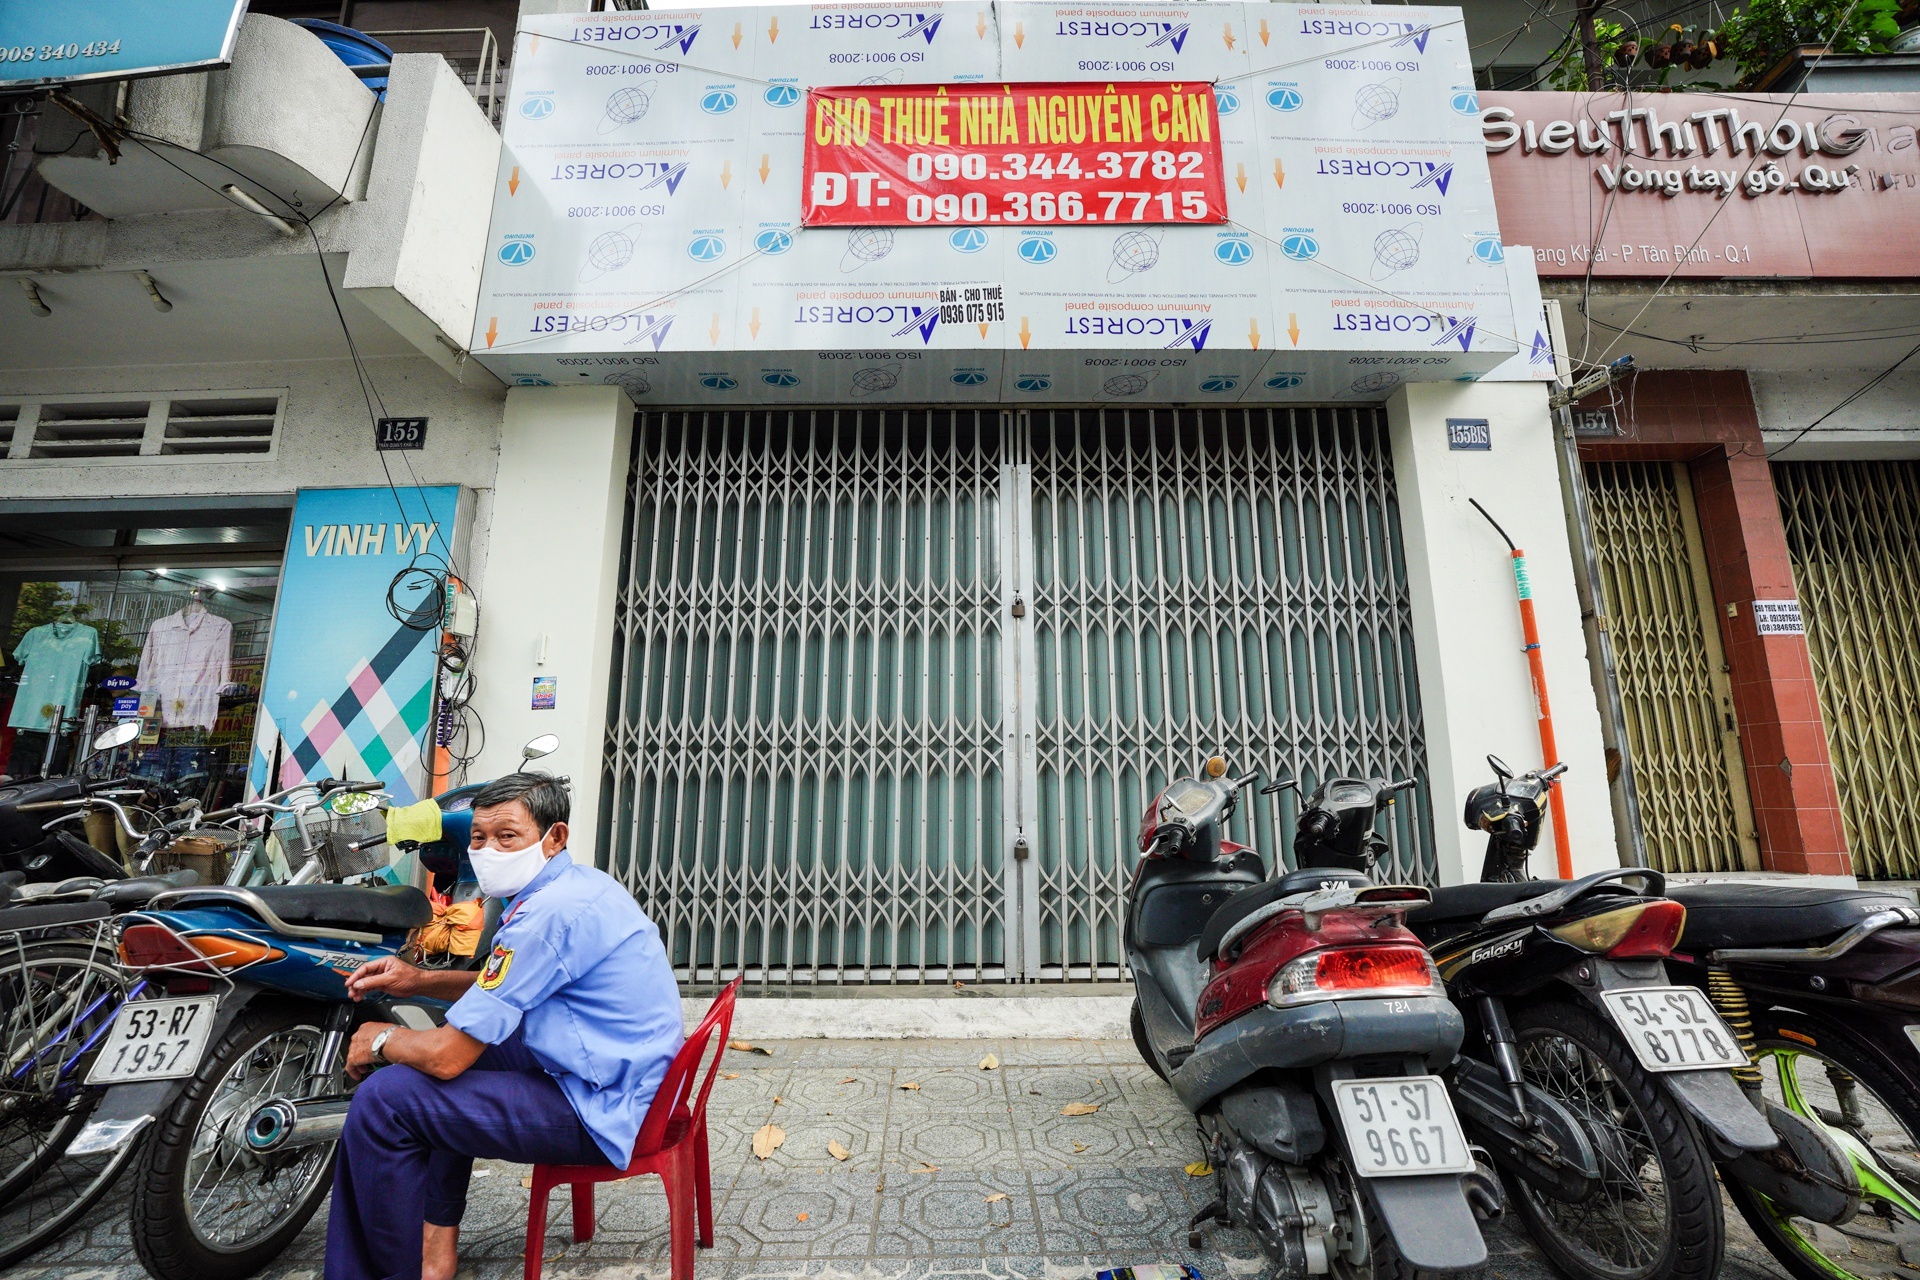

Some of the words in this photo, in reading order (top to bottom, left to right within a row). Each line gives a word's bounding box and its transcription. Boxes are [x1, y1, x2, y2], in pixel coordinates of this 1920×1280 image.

[602, 14, 651, 23] composite
[654, 12, 702, 22] Aluminum
[1056, 9, 1082, 17] panel
[1085, 9, 1136, 18] composite
[1328, 9, 1378, 18] composite
[1382, 11, 1429, 19] Aluminum
[573, 15, 599, 24] panel
[810, 13, 944, 45] ALCOREST
[570, 24, 702, 56] ALCOREST
[1056, 22, 1191, 54] ALCOREST
[1300, 20, 1431, 55] ALCOREST
[0, 47, 36, 63] 908
[38, 43, 79, 61] 340
[81, 38, 122, 57] 434
[829, 53, 895, 63] 9001:2008
[900, 52, 924, 62] ISO
[586, 64, 651, 76] 9001:2008
[655, 63, 679, 73] ISO
[1079, 60, 1145, 71] 9001:2008
[1150, 61, 1174, 71] ISO
[1325, 59, 1391, 71] 9001:2008
[1395, 61, 1420, 71] ISO
[815, 99, 871, 146] CHO
[881, 87, 950, 145] THUÊ
[960, 86, 1019, 144] NHÀ
[1030, 84, 1142, 143] NGUYÊN
[1154, 84, 1211, 143] CĂN
[555, 151, 581, 160] panel
[585, 149, 636, 159] composite
[640, 149, 690, 158] Aluminum
[1314, 146, 1342, 155] panel
[1345, 147, 1398, 156] composite
[1401, 148, 1452, 158] Aluminum
[907, 152, 1205, 181] 090.344.3782
[550, 162, 690, 197] ALCOREST
[1317, 159, 1454, 197] ALCOREST
[1601, 163, 1683, 196] Vòng
[1685, 164, 1736, 196] tay
[1743, 160, 1784, 196] gỗ
[811, 171, 891, 207] ĐT:
[568, 206, 635, 217] 9001:2008
[640, 205, 665, 215] ISO
[907, 192, 1209, 222] 090.366.7715
[1342, 202, 1412, 215] 9001:2008
[1417, 204, 1441, 214] ISO
[1673, 244, 1709, 264] Định
[1725, 245, 1750, 264] Q.1
[797, 291, 826, 300] panel
[830, 291, 884, 301] composite
[888, 291, 939, 300] Aluminum
[940, 287, 957, 303] BÁN
[964, 288, 980, 302] CHO
[982, 284, 1002, 301] THUÊ
[534, 302, 563, 311] panel
[566, 300, 620, 310] composite
[624, 300, 676, 309] Aluminum
[1065, 301, 1095, 311] panel
[1099, 302, 1154, 312] composite
[1158, 302, 1211, 313] Aluminum
[1331, 299, 1360, 308] panel
[1364, 299, 1418, 309] composite
[1421, 301, 1474, 310] Aluminum
[940, 304, 964, 324] 0936
[966, 303, 984, 323] 075
[986, 302, 1004, 322] 915
[795, 306, 939, 345] ALCOREST
[530, 315, 676, 352] ALCOREST
[1065, 317, 1213, 354] ALCOREST
[1333, 314, 1477, 353] ALCOREST
[557, 357, 630, 365] 9001:2008
[634, 357, 659, 365] ISO
[818, 352, 890, 360] 9001:2008
[895, 352, 921, 360] ISO
[1349, 357, 1421, 365] 9001:2008
[1576, 412, 1607, 430] 157
[383, 421, 420, 442] 155
[1450, 425, 1488, 444] 155BIS
[305, 523, 387, 557] VINH
[394, 522, 440, 555] VY
[1320, 880, 1350, 891] SYM
[1471, 939, 1523, 965] Galaxy
[1384, 1002, 1411, 1014] 721
[1622, 995, 1708, 1025] 54-S2
[127, 1005, 201, 1041] 53-R7
[1644, 1029, 1730, 1064] 8778
[111, 1040, 188, 1075] 1957
[1351, 1084, 1432, 1123] 51-S7
[1366, 1127, 1447, 1167] 9667
